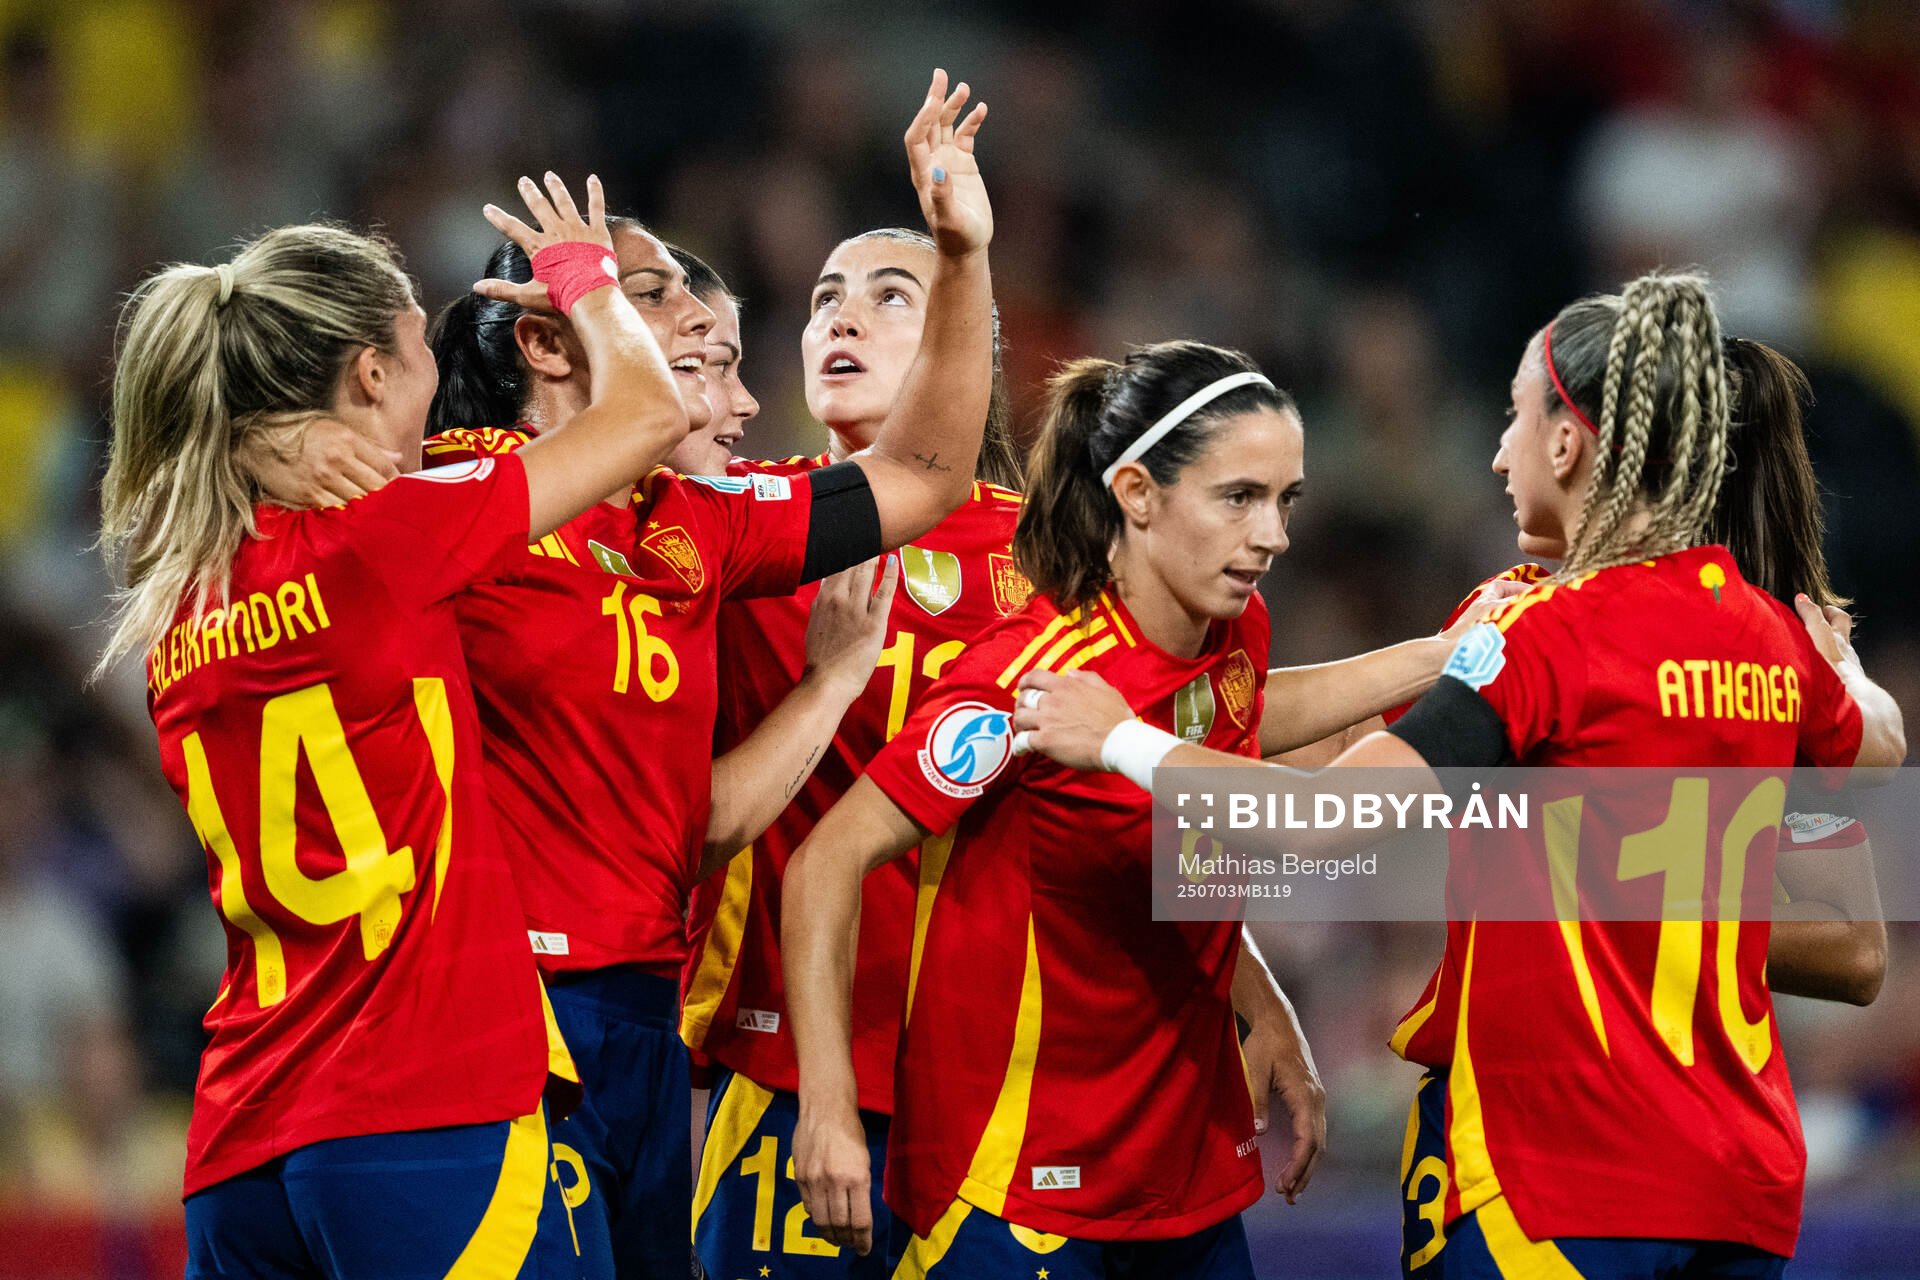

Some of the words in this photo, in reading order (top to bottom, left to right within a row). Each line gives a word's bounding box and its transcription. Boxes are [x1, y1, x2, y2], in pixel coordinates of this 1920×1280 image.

[602, 580, 680, 703] 16
[1656, 659, 1800, 723] ATHENEA
[921, 752, 960, 795] SWITZERLAND
[182, 682, 416, 1009] 14
